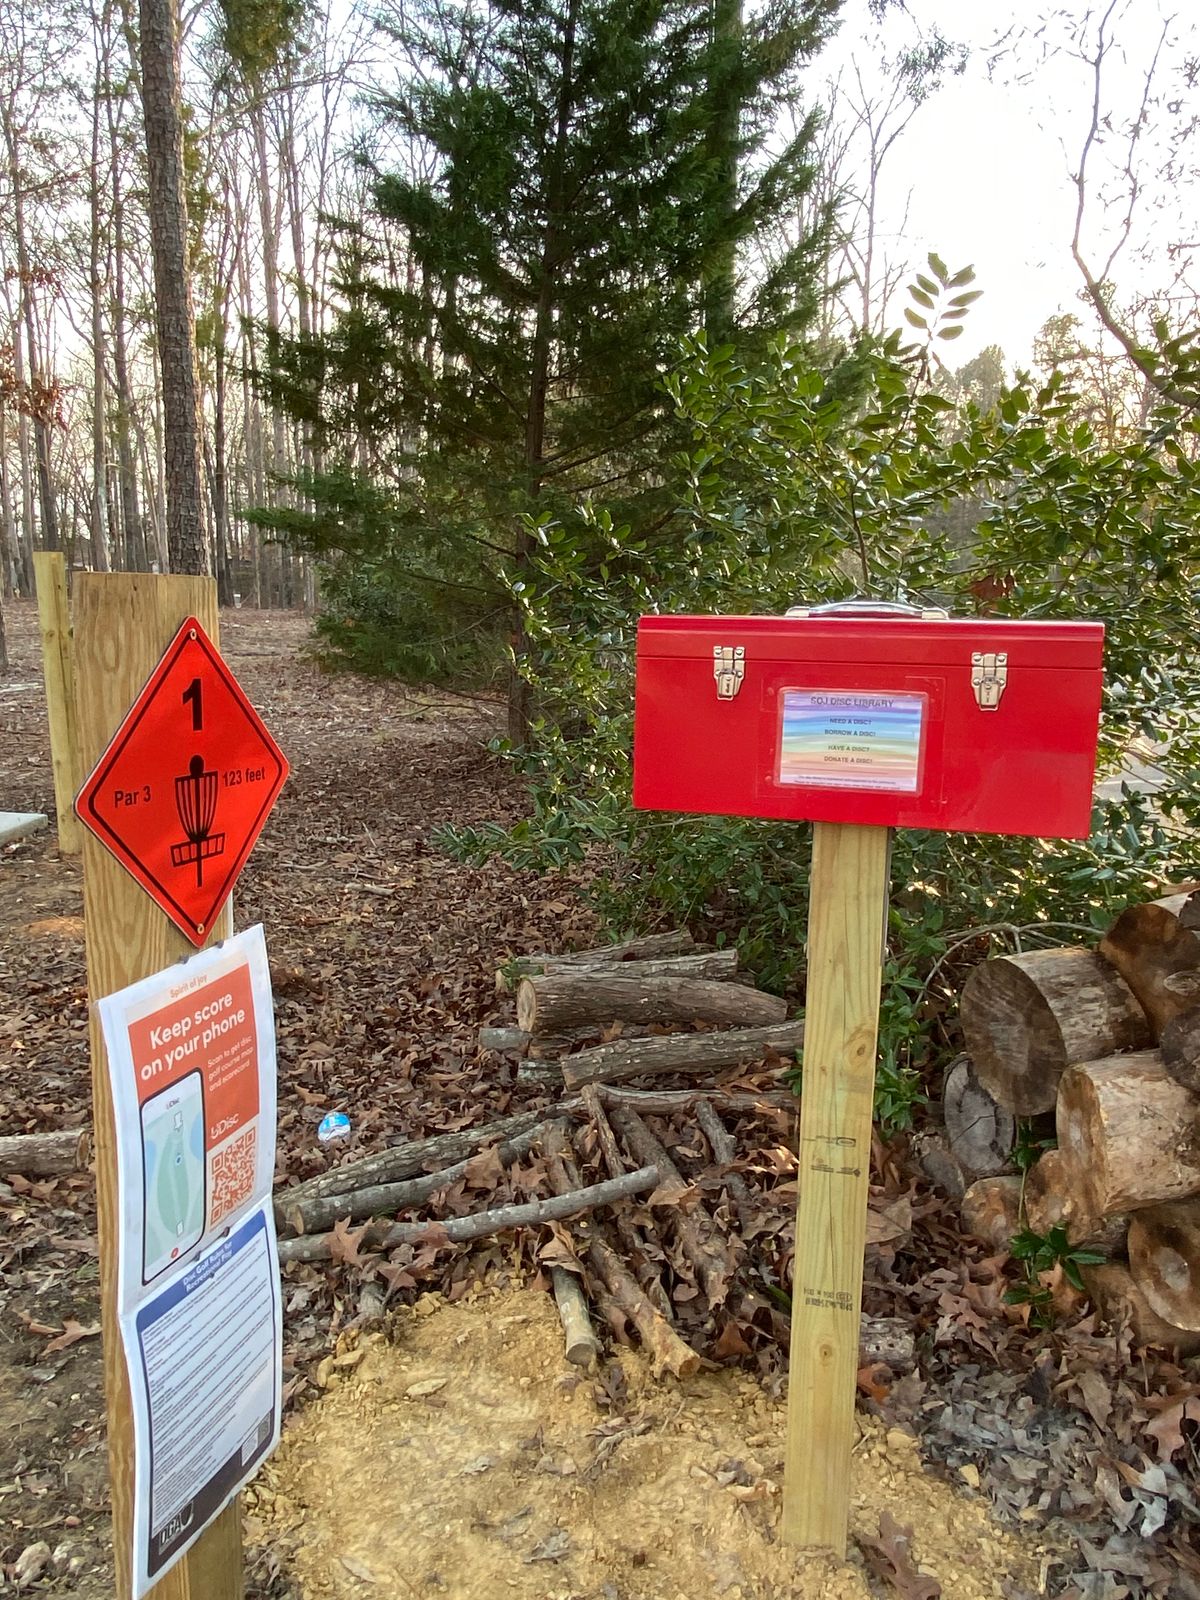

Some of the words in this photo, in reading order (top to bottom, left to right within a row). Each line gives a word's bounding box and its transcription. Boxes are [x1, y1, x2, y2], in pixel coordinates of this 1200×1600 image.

[182, 678, 203, 731] 1
[810, 697, 828, 705] SOJ
[830, 698, 851, 706] DISC
[854, 699, 894, 708] LIBRARY
[222, 770, 243, 787] 123
[245, 766, 266, 783] feet
[114, 789, 139, 808] Par
[142, 785, 151, 803] 3
[170, 982, 189, 999] Spirit
[150, 1016, 192, 1050] Keep
[194, 993, 233, 1025] score
[141, 1058, 163, 1081] on
[164, 1035, 200, 1071] your
[202, 1009, 245, 1049] phone
[207, 1054, 224, 1068] Scan
[223, 1049, 231, 1057] to
[230, 1041, 240, 1056] get
[240, 1035, 252, 1047] disc
[208, 1065, 221, 1081] golf
[221, 1055, 241, 1072] course
[241, 1046, 254, 1059] map
[209, 1077, 222, 1092] and
[222, 1059, 250, 1083] scorecard
[211, 1113, 239, 1139] UDisc
[183, 1272, 196, 1286] Disc
[195, 1259, 209, 1274] Golf
[209, 1249, 225, 1264] Rules
[186, 1258, 221, 1293] Recreational
